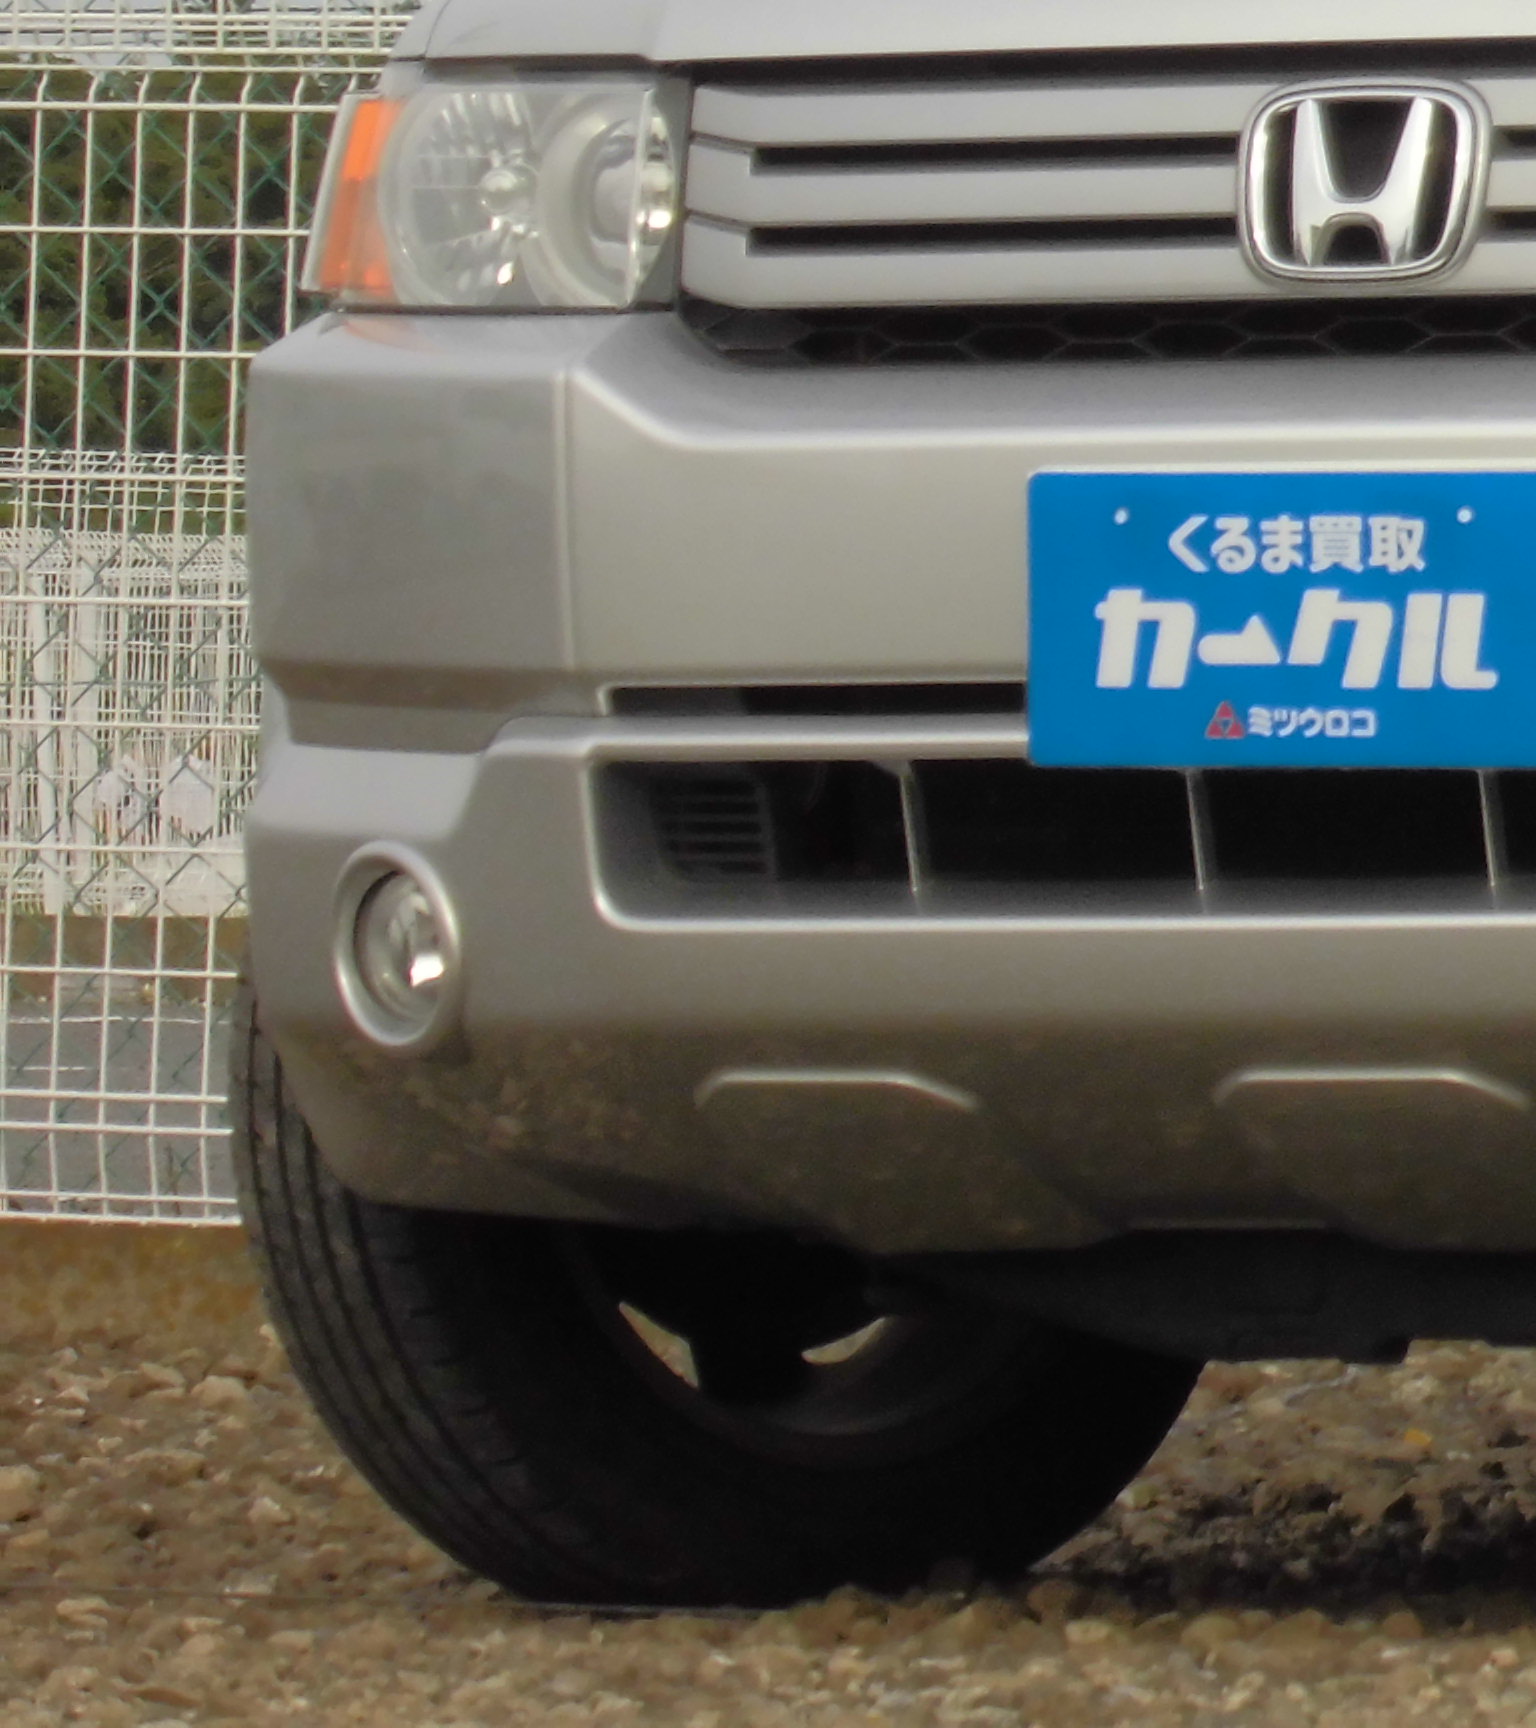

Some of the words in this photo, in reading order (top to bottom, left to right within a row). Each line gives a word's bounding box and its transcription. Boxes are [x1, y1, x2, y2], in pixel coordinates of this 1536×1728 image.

[1168, 514, 1427, 574] くるま買取
[1094, 588, 1500, 690] カークル
[1247, 705, 1377, 738] ミツウロコ
